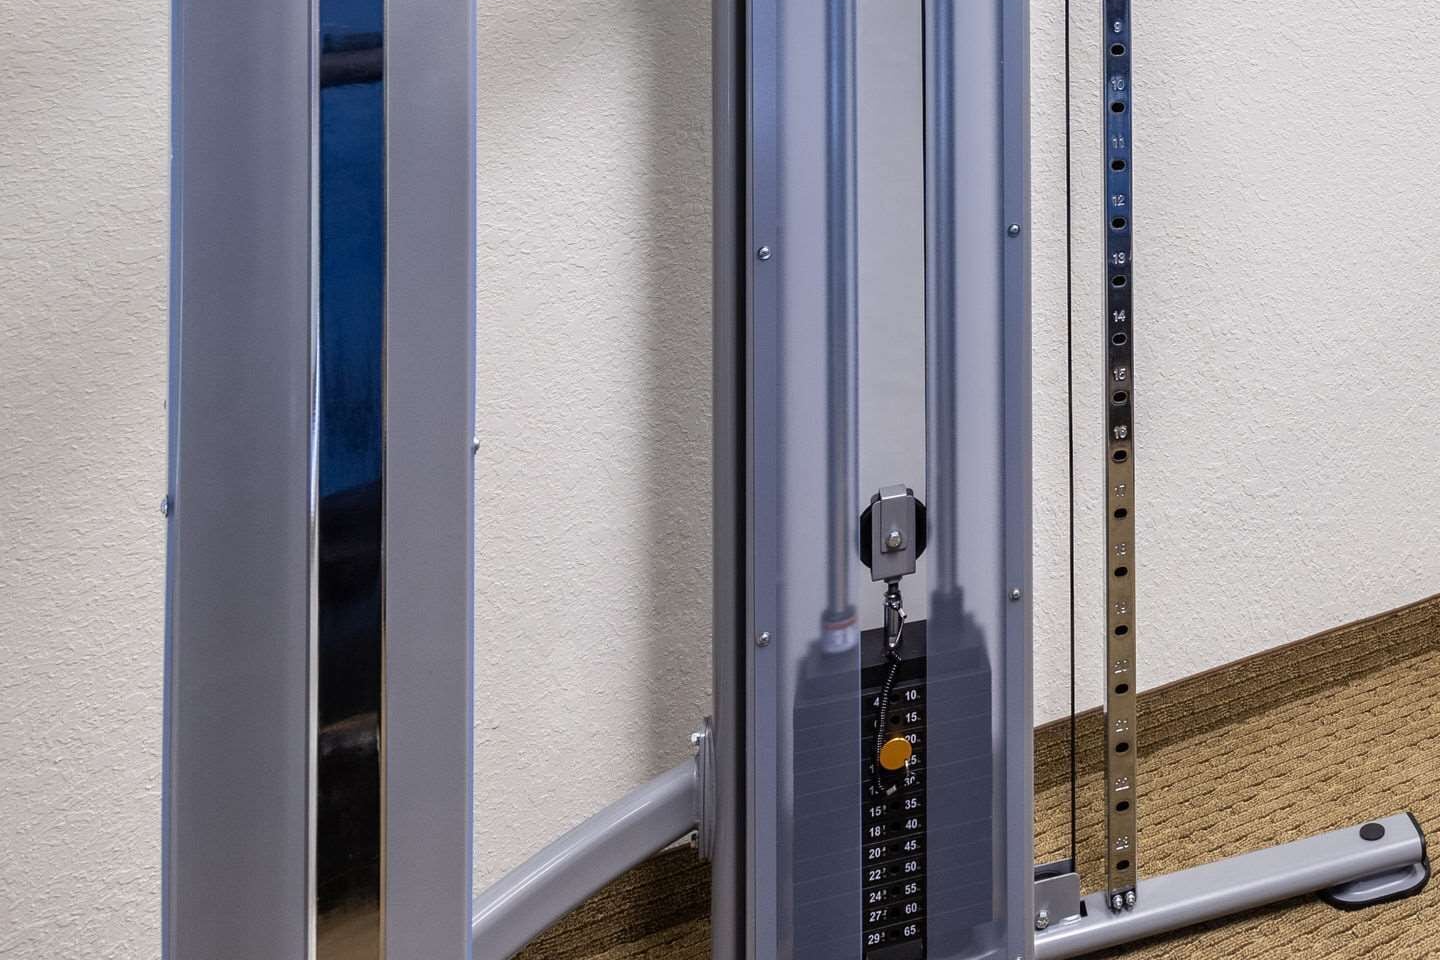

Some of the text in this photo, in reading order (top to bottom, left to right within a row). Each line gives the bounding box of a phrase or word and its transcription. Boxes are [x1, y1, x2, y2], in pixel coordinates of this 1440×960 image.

[1113, 21, 1121, 33] 9
[1111, 79, 1125, 91] 10
[1112, 137, 1125, 149] 11
[1112, 195, 1125, 207] 12
[1112, 252, 1125, 265] 13
[1113, 310, 1126, 322] 14
[1113, 367, 1126, 381] 15
[1113, 425, 1127, 439] 16
[905, 689, 917, 701] 10
[905, 712, 917, 723] 15
[905, 798, 917, 810] 35
[869, 806, 882, 817] 15
[905, 819, 918, 830] 40
[868, 825, 881, 838] 18
[904, 840, 917, 851] 45
[868, 847, 881, 859] 20
[904, 861, 917, 872] 50
[869, 869, 881, 881] 22
[904, 883, 917, 895] 55
[869, 891, 882, 903] 24
[905, 902, 918, 914] 60
[869, 910, 882, 922] 27
[904, 925, 917, 936] 65
[868, 933, 880, 944] 29
